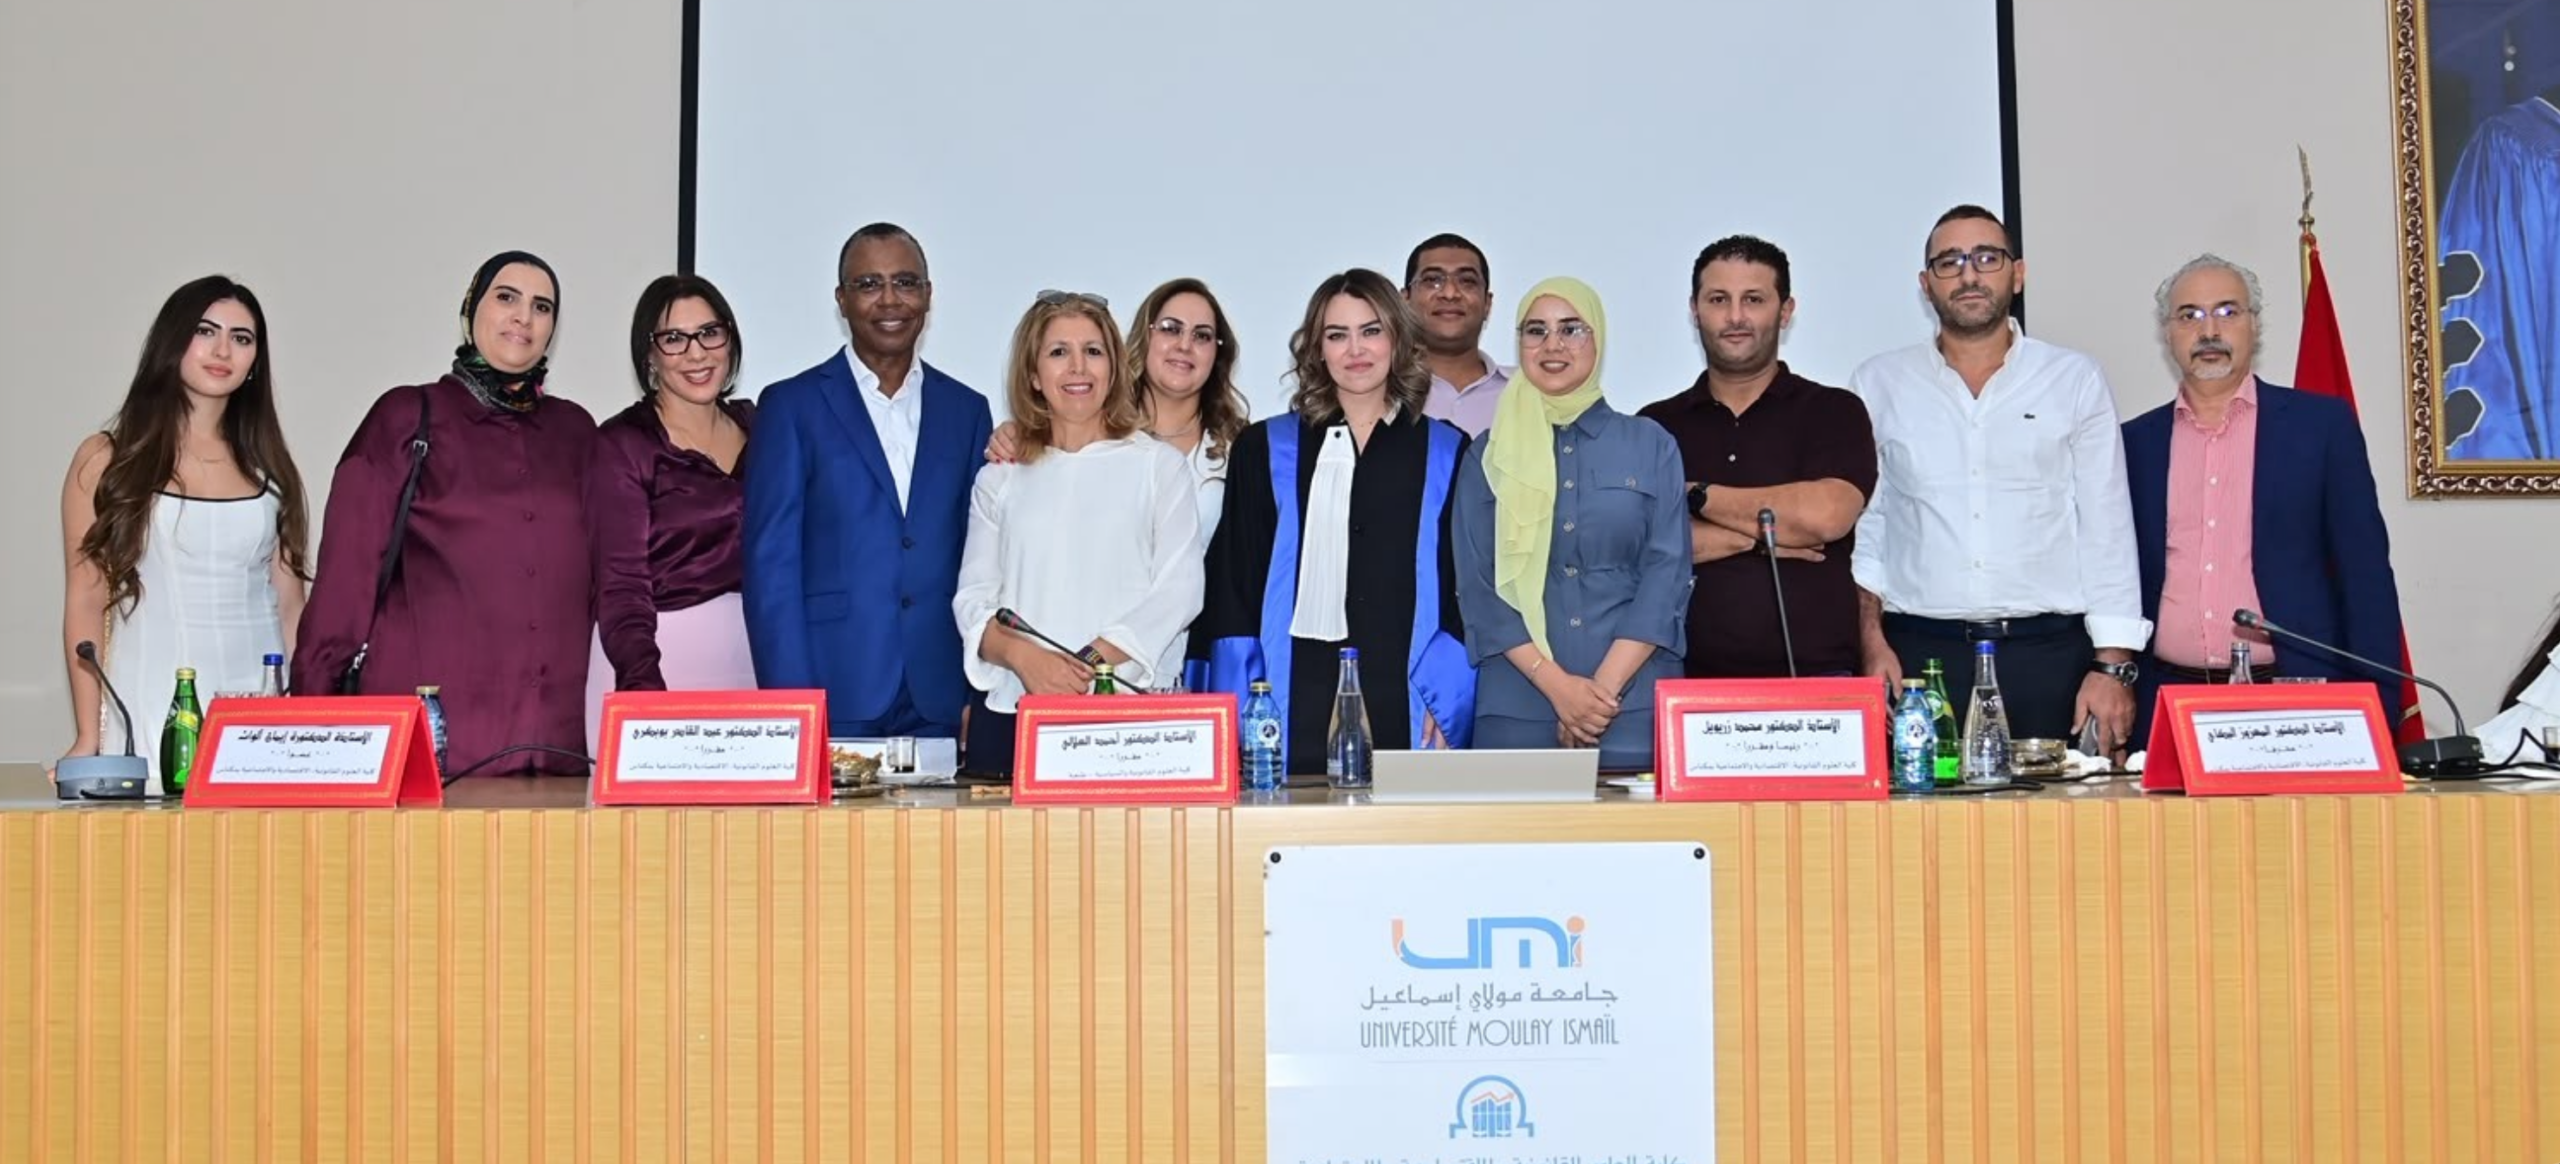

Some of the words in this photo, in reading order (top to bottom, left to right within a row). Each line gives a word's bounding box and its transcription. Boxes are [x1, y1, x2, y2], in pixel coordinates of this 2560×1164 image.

[1361, 982, 1461, 1011] إسماعيل
[1469, 982, 1522, 1012] مولاي
[1530, 981, 1619, 1008] جامعة
[1360, 1015, 1458, 1048] UNIVERSITÉ
[1466, 1018, 1553, 1047] MOULAY
[1563, 1013, 1620, 1046] ISMAÏL
